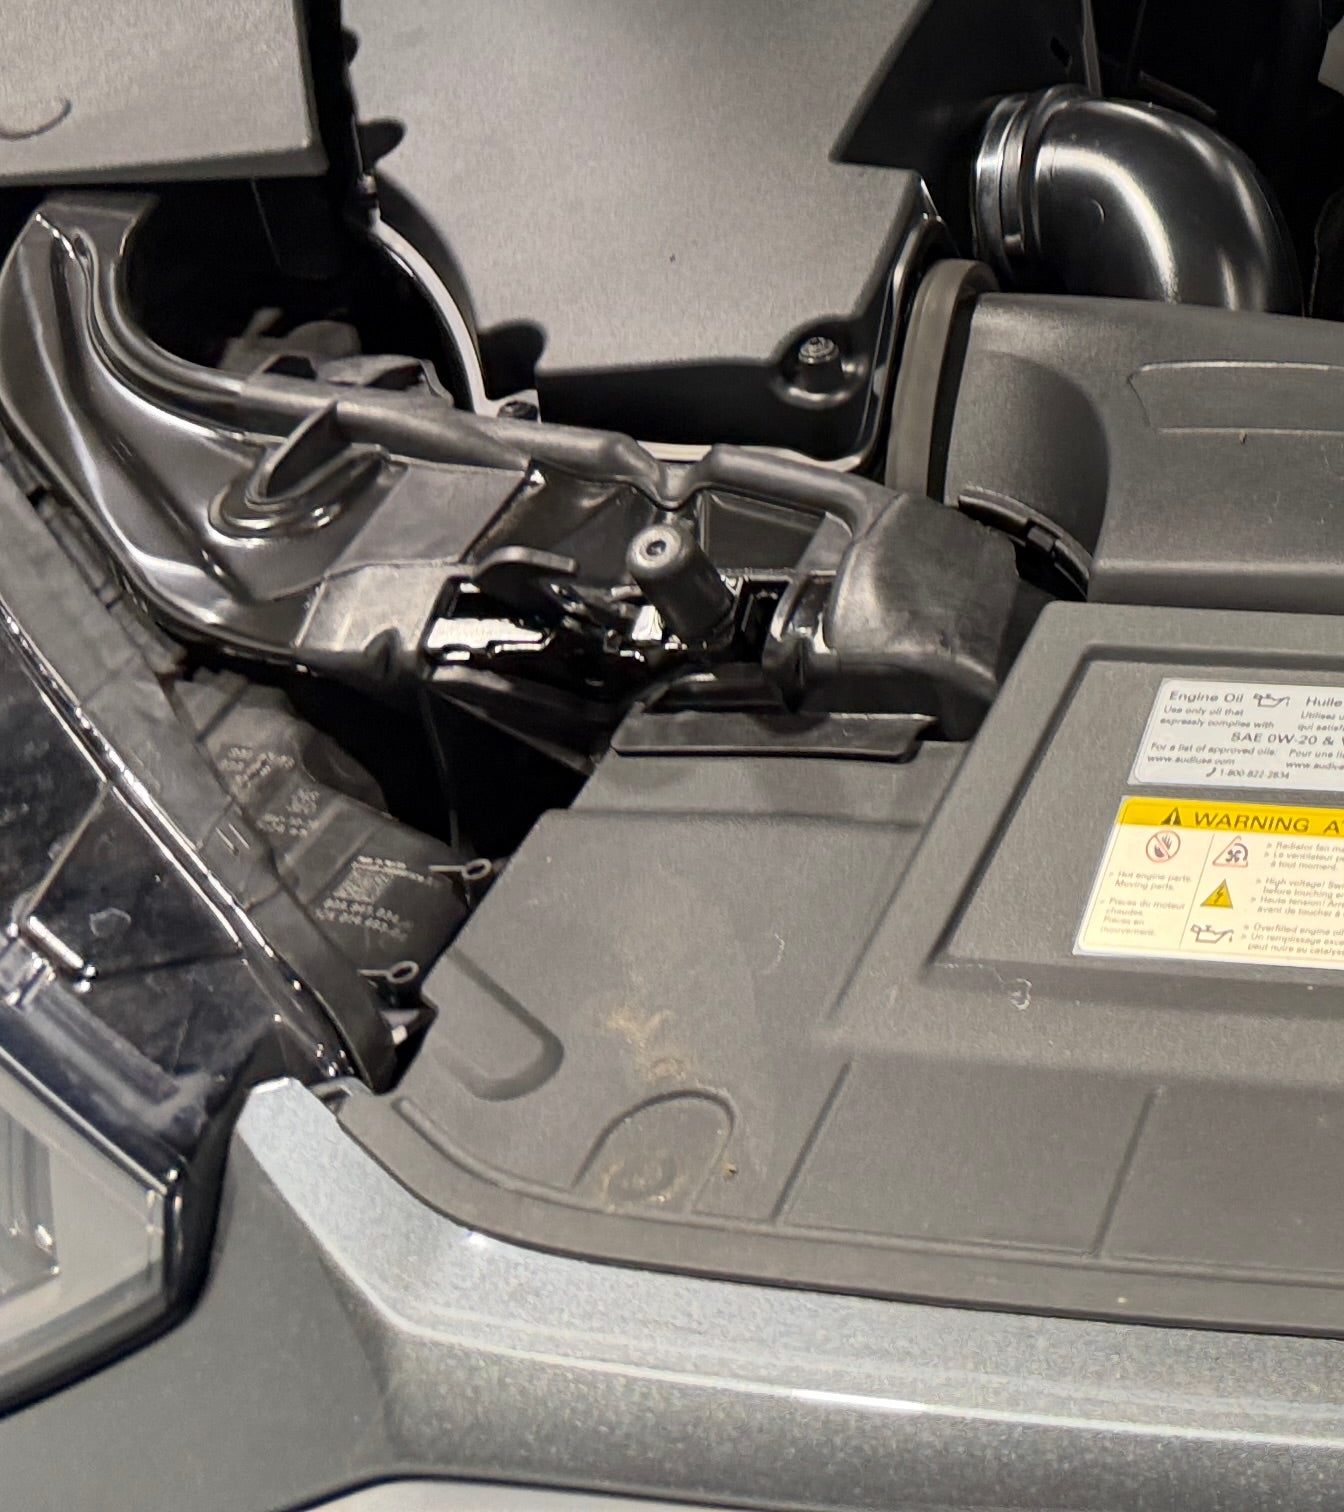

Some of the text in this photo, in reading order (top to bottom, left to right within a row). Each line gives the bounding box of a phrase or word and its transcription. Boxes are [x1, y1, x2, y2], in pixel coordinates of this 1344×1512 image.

[1169, 691, 1243, 703] Engine Oil
[1305, 696, 1342, 707] Huile
[1163, 704, 1243, 716] Use only oil that
[1159, 718, 1203, 726] expressly
[1207, 720, 1250, 728] complies
[1297, 723, 1314, 731] qui
[1230, 732, 1262, 742] SAE
[1267, 733, 1317, 745] 0W-20
[1321, 736, 1333, 745] &
[1150, 741, 1166, 751] For
[1177, 743, 1193, 752] list
[1194, 743, 1206, 752] of
[1207, 746, 1255, 755] approved
[1288, 748, 1312, 757] Pour
[1194, 812, 1308, 832] WARNING
